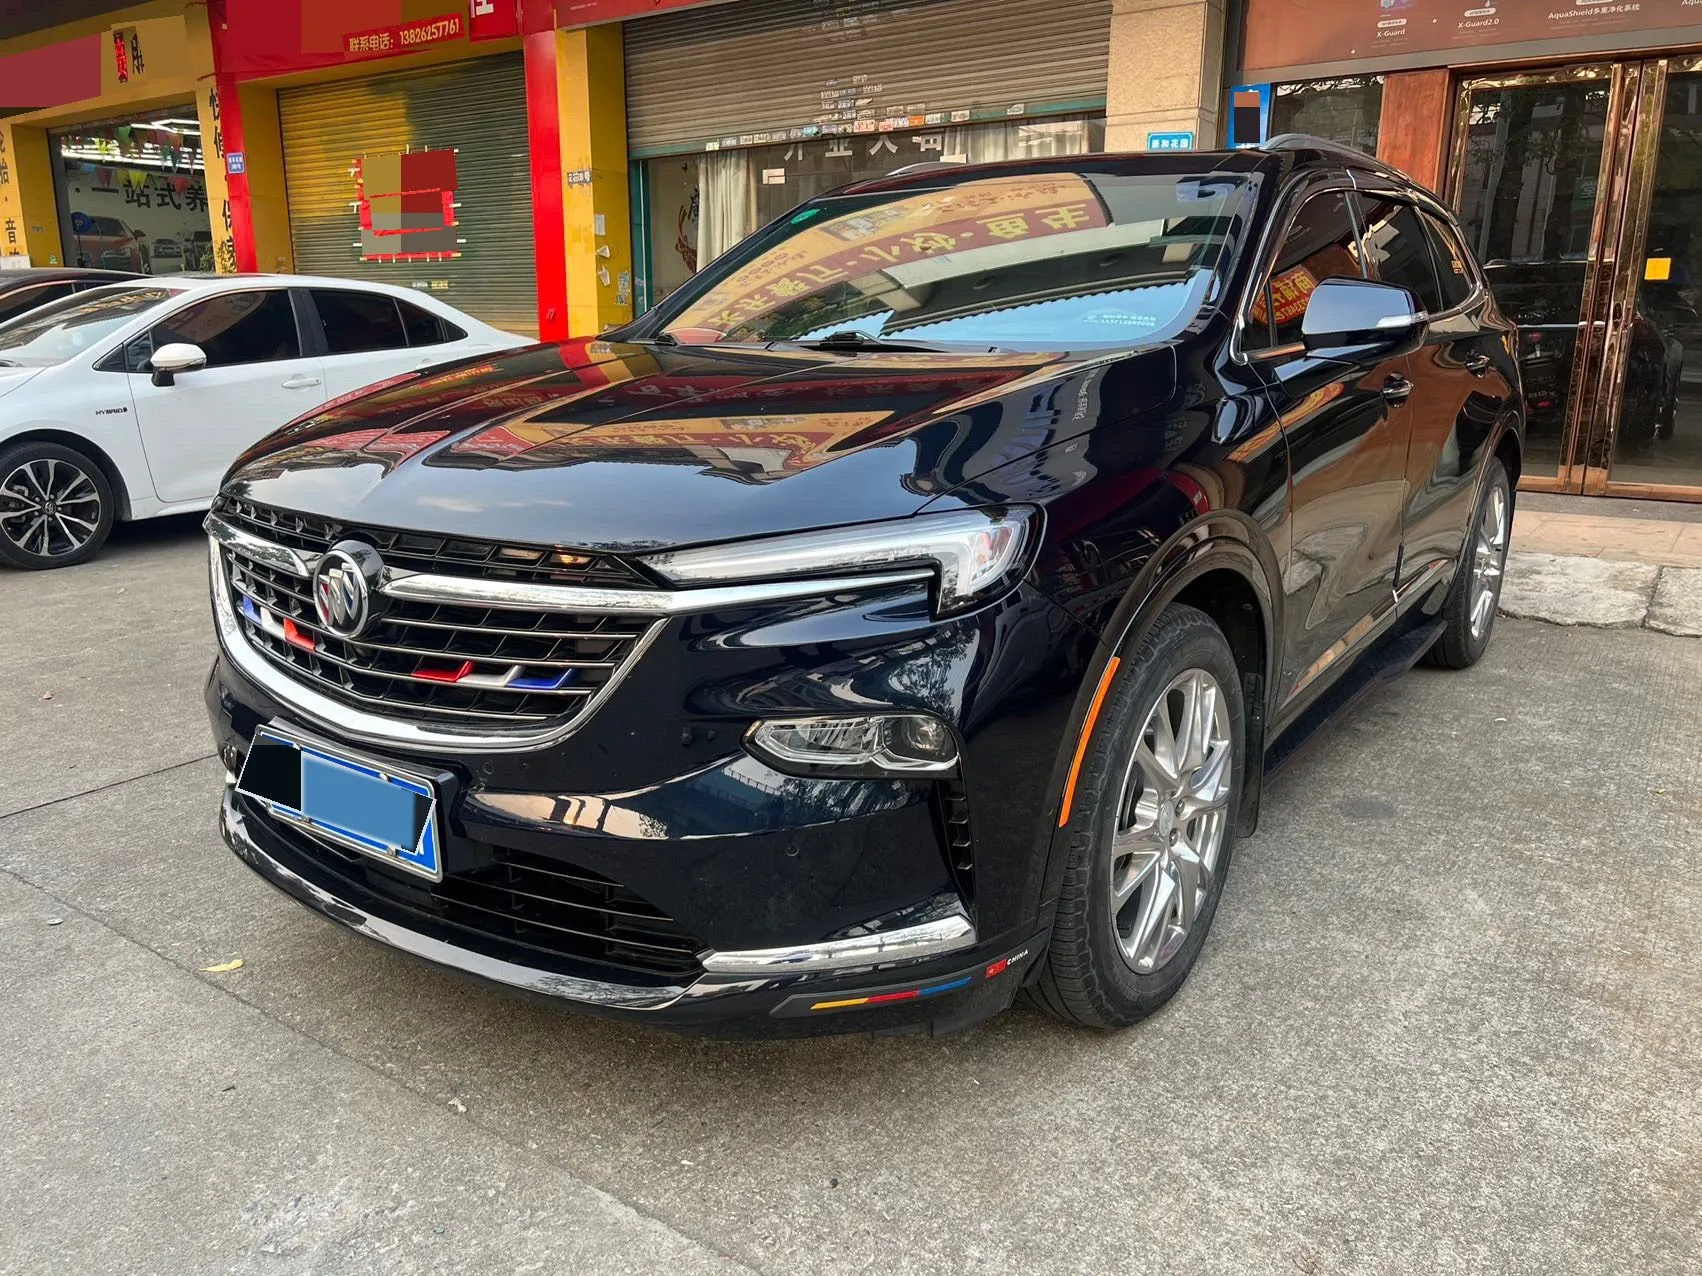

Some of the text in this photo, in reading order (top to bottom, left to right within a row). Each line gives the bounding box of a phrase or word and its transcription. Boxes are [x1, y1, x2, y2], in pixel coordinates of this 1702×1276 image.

[1457, 18, 1500, 29] X-Guard2.0
[1376, 28, 1406, 38] X-Guard
[95, 407, 123, 416] HYBRID
[1007, 948, 1029, 966] CHINA
